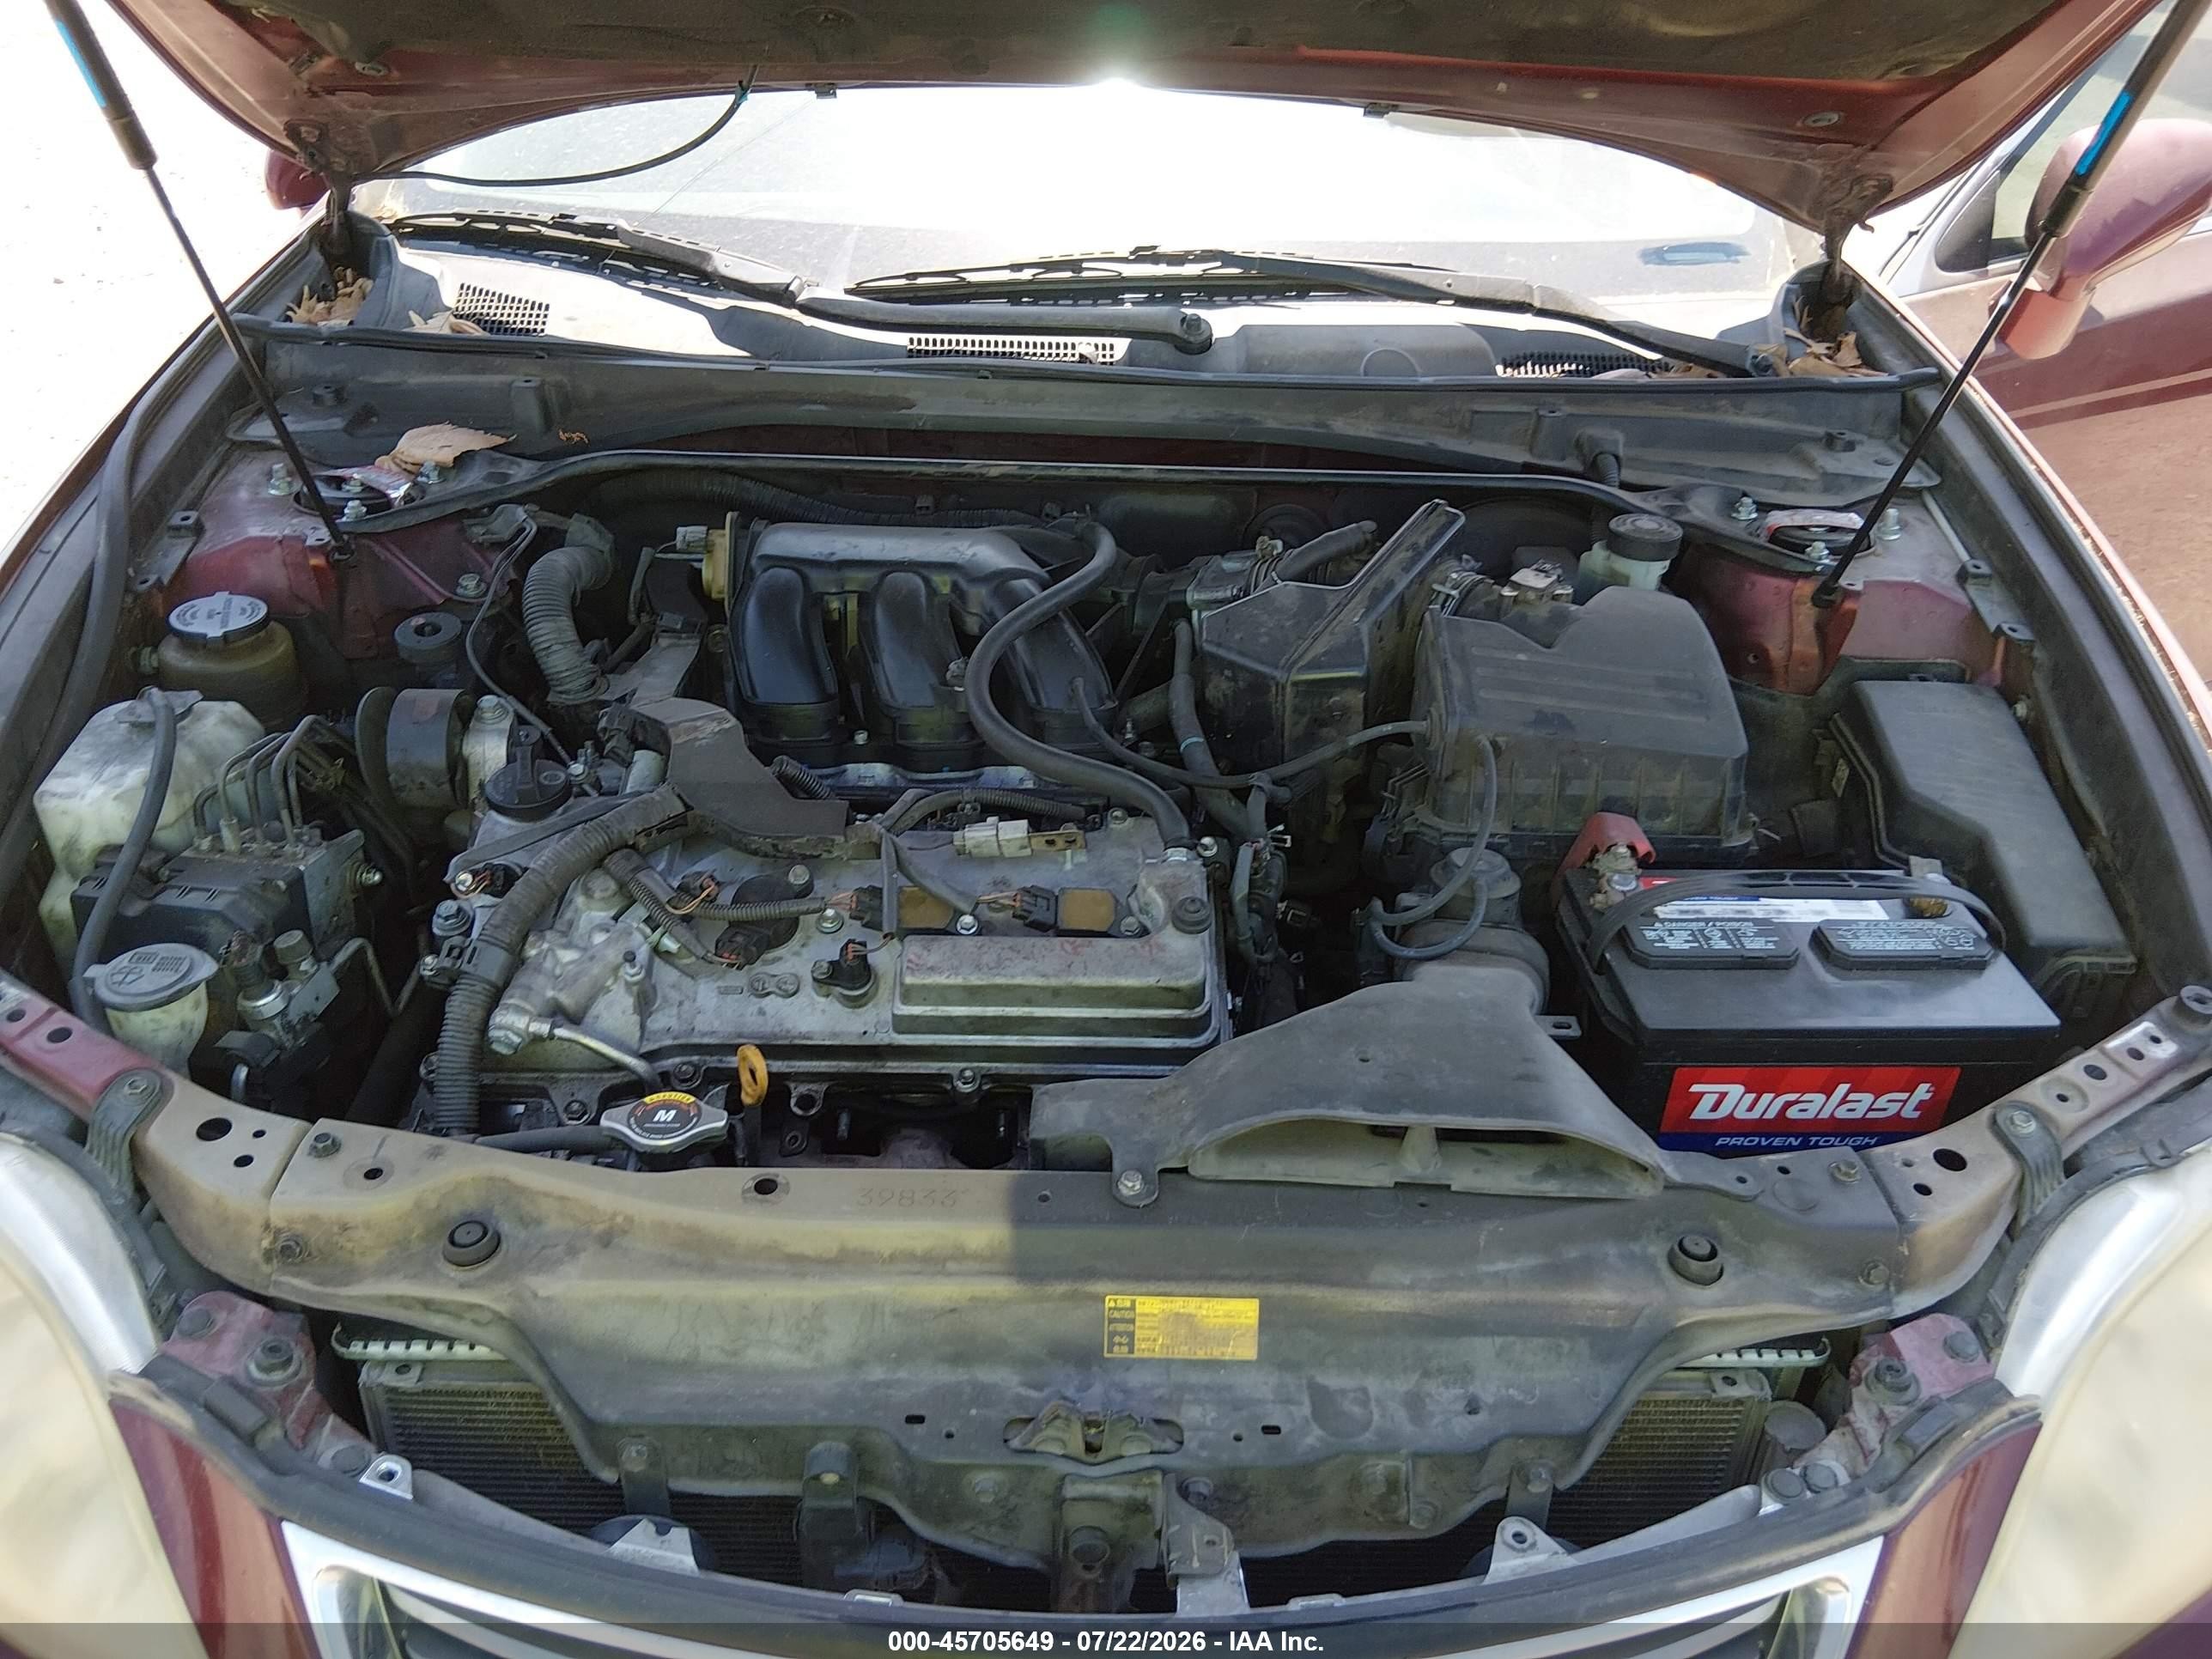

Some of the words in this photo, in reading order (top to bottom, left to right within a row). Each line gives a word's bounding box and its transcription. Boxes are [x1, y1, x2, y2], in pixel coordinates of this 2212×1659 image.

[1688, 1083, 1934, 1120] Duralast
[653, 1109, 678, 1122] M
[1715, 1136, 1803, 1146] PROVEN
[1808, 1136, 1879, 1146] TOUGH
